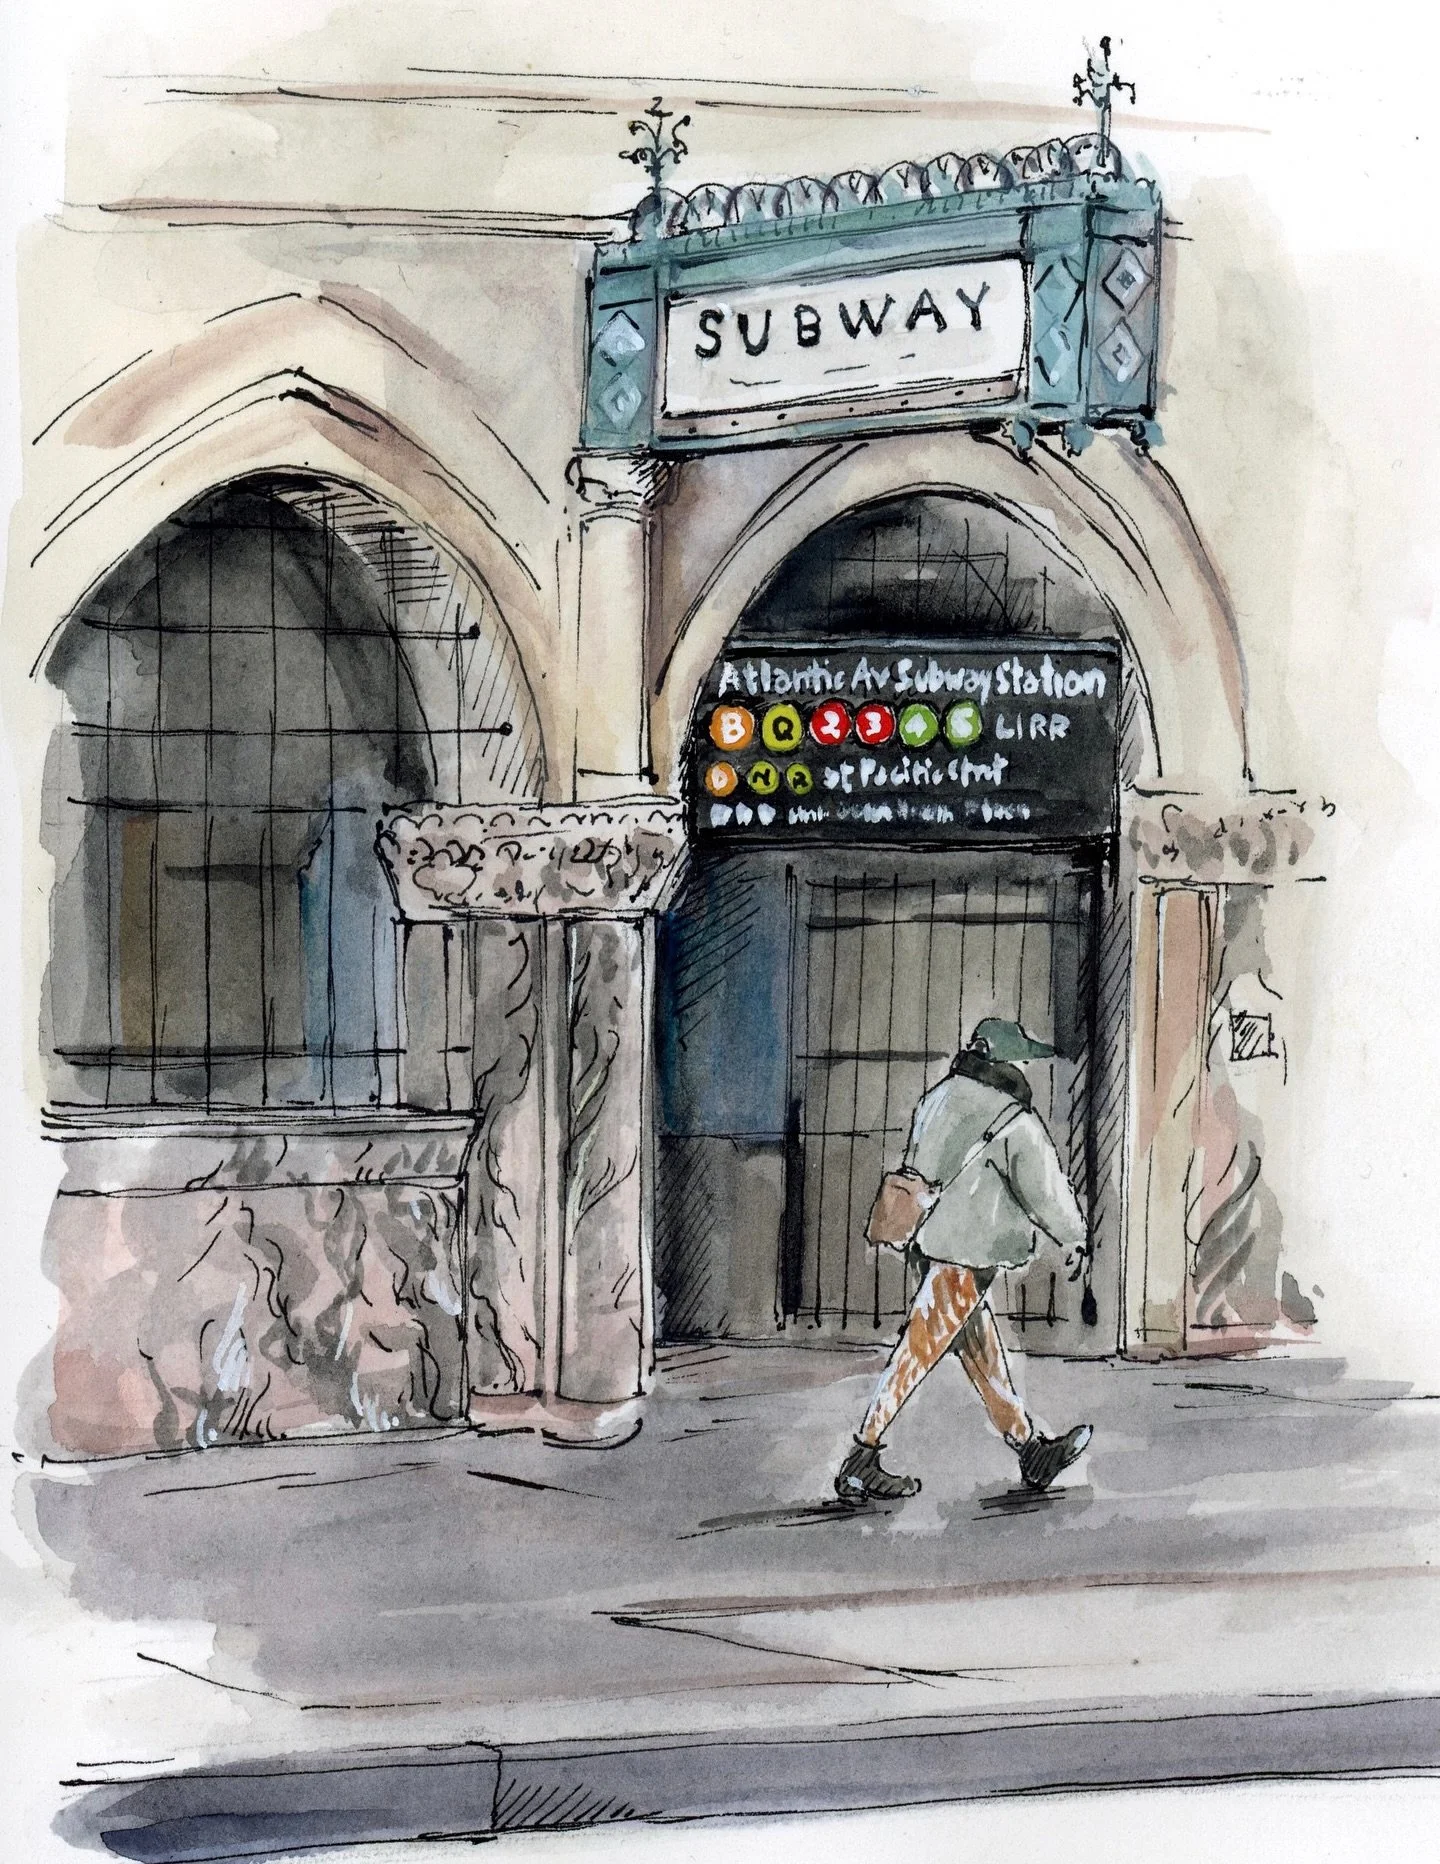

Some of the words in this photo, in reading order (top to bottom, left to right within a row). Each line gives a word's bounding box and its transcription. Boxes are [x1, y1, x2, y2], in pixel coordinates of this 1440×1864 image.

[695, 281, 990, 359] SUBWAY
[718, 658, 846, 698] Atlantic
[851, 656, 891, 693] Av
[895, 656, 992, 706] Subway
[995, 653, 1106, 699] Station
[720, 711, 747, 745] B
[995, 712, 1071, 742] LIRR
